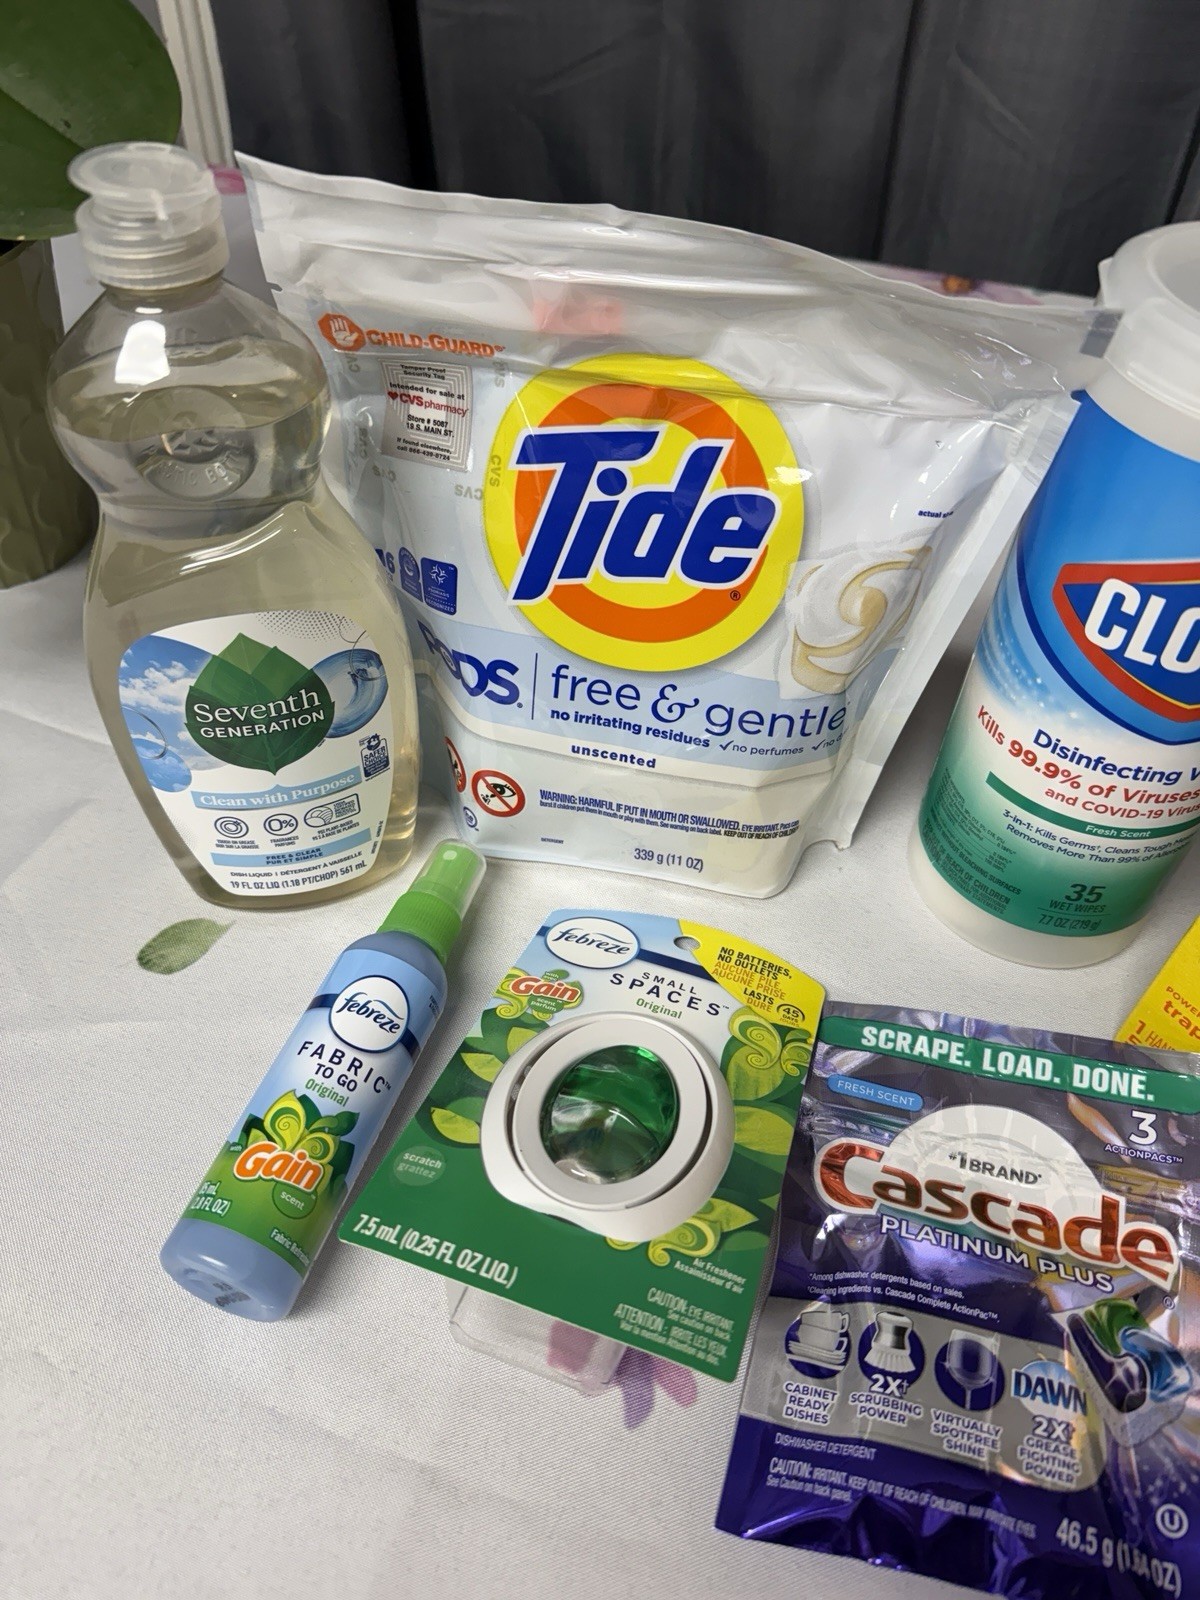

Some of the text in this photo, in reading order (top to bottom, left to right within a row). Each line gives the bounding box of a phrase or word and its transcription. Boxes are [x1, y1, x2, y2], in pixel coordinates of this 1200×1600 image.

[366, 329, 496, 357] CHILD-GUARD
[389, 382, 424, 392] Intended
[425, 387, 437, 395] for
[439, 390, 455, 398] sale
[407, 414, 425, 424] Store
[424, 426, 442, 435] MAIN
[402, 438, 419, 447] found
[510, 428, 779, 603] Tide
[918, 509, 942, 519] actual
[193, 687, 322, 724] Seventh
[551, 664, 846, 738] free & gentle
[200, 709, 326, 740] GENERATION
[550, 708, 711, 749] no irritating residues
[364, 745, 386, 761] SAFER
[571, 744, 657, 769] unscented
[732, 743, 803, 756] no perfumes
[977, 705, 1200, 806] Kills 99.9% of Viruses
[1032, 728, 1184, 786] Disinfecting
[200, 773, 355, 807] Clean with Purpose
[1045, 787, 1078, 807] and
[1081, 800, 1164, 819] COVID-19
[540, 789, 740, 831] WARNING: HARMFUL IF PUT IN MOUTH OR SWALLOWED.
[267, 818, 295, 833] 0%
[1002, 808, 1034, 832] 3-in-1:
[1035, 824, 1058, 842] Kills
[1104, 846, 1140, 855] Cleans
[1085, 824, 1152, 838] Fresh Scent
[295, 847, 321, 858] CLEAR
[1006, 823, 1141, 864] Removes More Than 99%
[295, 852, 324, 863] SIMPLE
[329, 851, 363, 867] VAISSELLE
[634, 847, 704, 873] 339 g OZ)
[241, 859, 367, 890] FL OZ PT/CHOP) 561 mL
[958, 849, 1022, 896] BLEACHING SURFACES
[973, 879, 1012, 906] CHILDREN
[1049, 899, 1107, 913] WET WIPES
[1064, 882, 1107, 904] 35
[1053, 917, 1070, 928] OZ
[552, 926, 632, 955] febreze
[717, 954, 779, 981] NO OUTLETS
[720, 946, 792, 979] NO BATTERIES,
[510, 976, 581, 1003] Gain
[642, 971, 697, 995] SMALL
[711, 968, 787, 1001] AUCUNE PRISE
[715, 961, 782, 992] AUCUNE PILE,
[636, 998, 682, 1019] Original
[743, 987, 775, 1006] LASTS
[746, 997, 774, 1014] DURE
[336, 992, 405, 1035] febreze
[781, 1013, 800, 1023] DAYS
[782, 1006, 801, 1019] 45
[861, 1025, 1156, 1102] SCRAPE. LOAD. DONE.
[314, 1063, 358, 1093] TO GO
[305, 1078, 350, 1108] Original
[837, 1079, 915, 1107] FRESH SCENT
[1129, 1110, 1157, 1146] 3
[233, 1140, 325, 1193] Gain
[396, 1161, 437, 1179] grattez
[403, 1151, 442, 1169] scratch
[280, 1191, 305, 1211] scent
[816, 1139, 1180, 1288] Cascade
[270, 1228, 292, 1249] Fabric
[353, 1213, 519, 1289] 7.5 mL (0.25 FL OZ LIQ.)
[880, 1213, 1114, 1294] PLATINUM PLUS
[674, 1260, 725, 1287] Assainisseur
[705, 1261, 746, 1285] Freshener
[834, 1270, 965, 1299] dishwasher detergents based on sales.
[647, 1286, 689, 1314] CAUTION:
[837, 1284, 951, 1311] ingredients Cascade Complete
[784, 1381, 838, 1402] CABINET
[788, 1394, 831, 1413] READY
[850, 1392, 922, 1417] SCRUBBING
[1012, 1369, 1088, 1416] DAWN
[783, 1406, 830, 1425] DISHES
[857, 1405, 907, 1424] POWER
[931, 1410, 1002, 1438] VIRTUALLY
[775, 1432, 877, 1460] DISHWASHER DETERGENT
[931, 1421, 1000, 1451] SPOTFREE
[944, 1437, 987, 1460] SHINE
[1025, 1435, 1077, 1458] GREASE
[1019, 1447, 1081, 1474] FIGHTING
[1024, 1461, 1076, 1484] POWER
[769, 1457, 895, 1498] CAUTION: KEEP OUT OF
[1056, 1517, 1098, 1556] 46.5
[1102, 1537, 1114, 1568] g
[1151, 1558, 1182, 1599] OZ)
